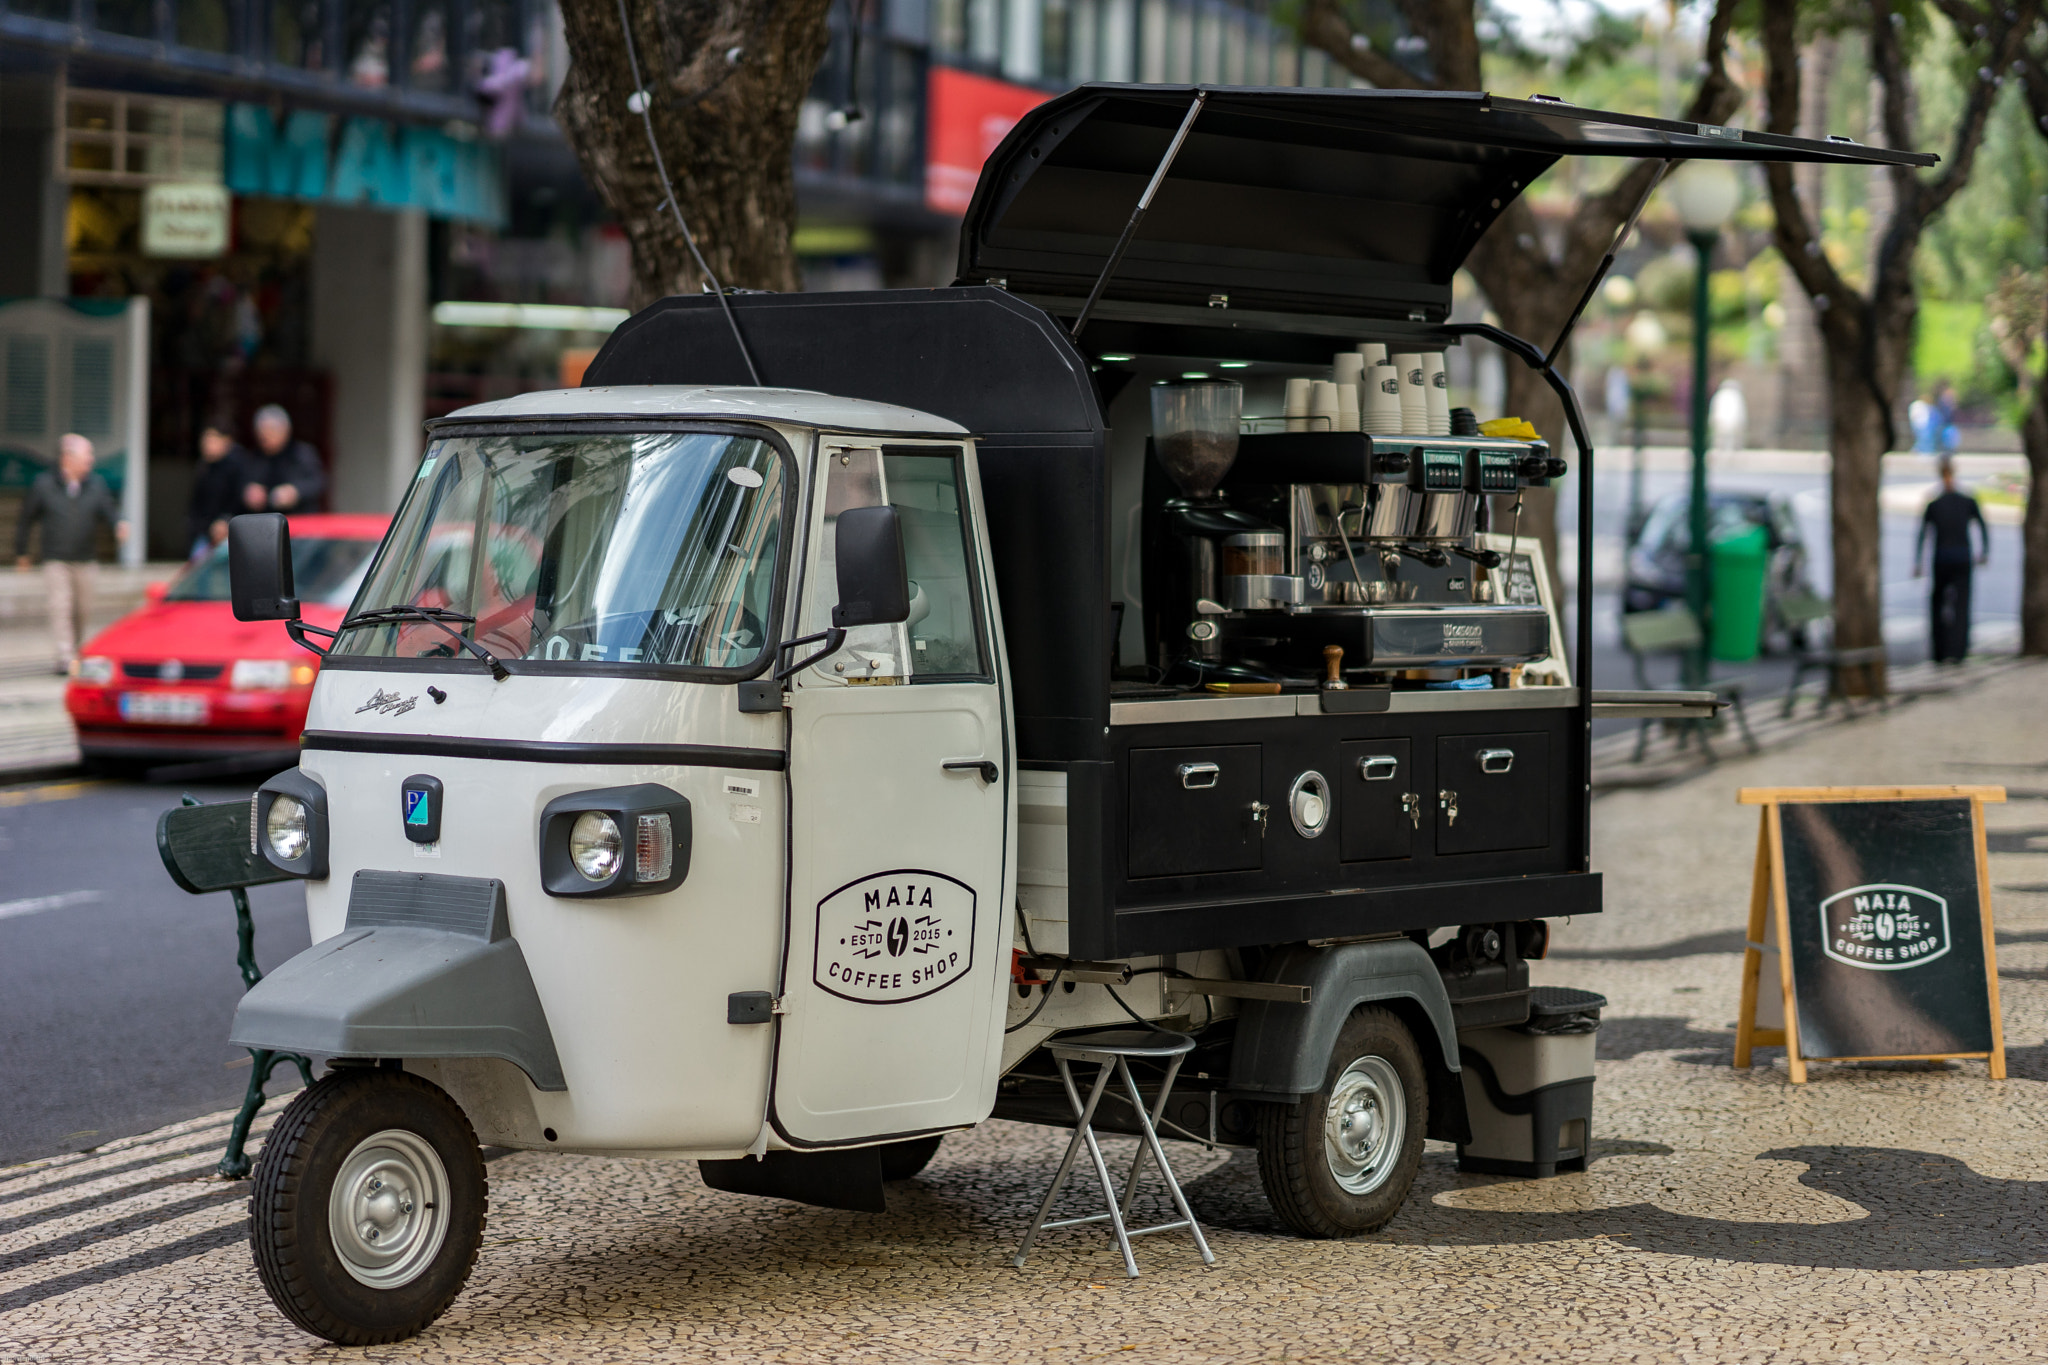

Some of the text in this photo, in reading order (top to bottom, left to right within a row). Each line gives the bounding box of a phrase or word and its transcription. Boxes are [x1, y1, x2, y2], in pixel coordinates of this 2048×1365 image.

[864, 885, 933, 913] MAIA
[1854, 893, 1911, 913] MAIA
[851, 928, 941, 946] ESTD 2015
[1849, 921, 1920, 932] ESTD 2015
[1835, 936, 1937, 961] COFFEE SHOP
[829, 951, 958, 989] COFFEE SHOP
